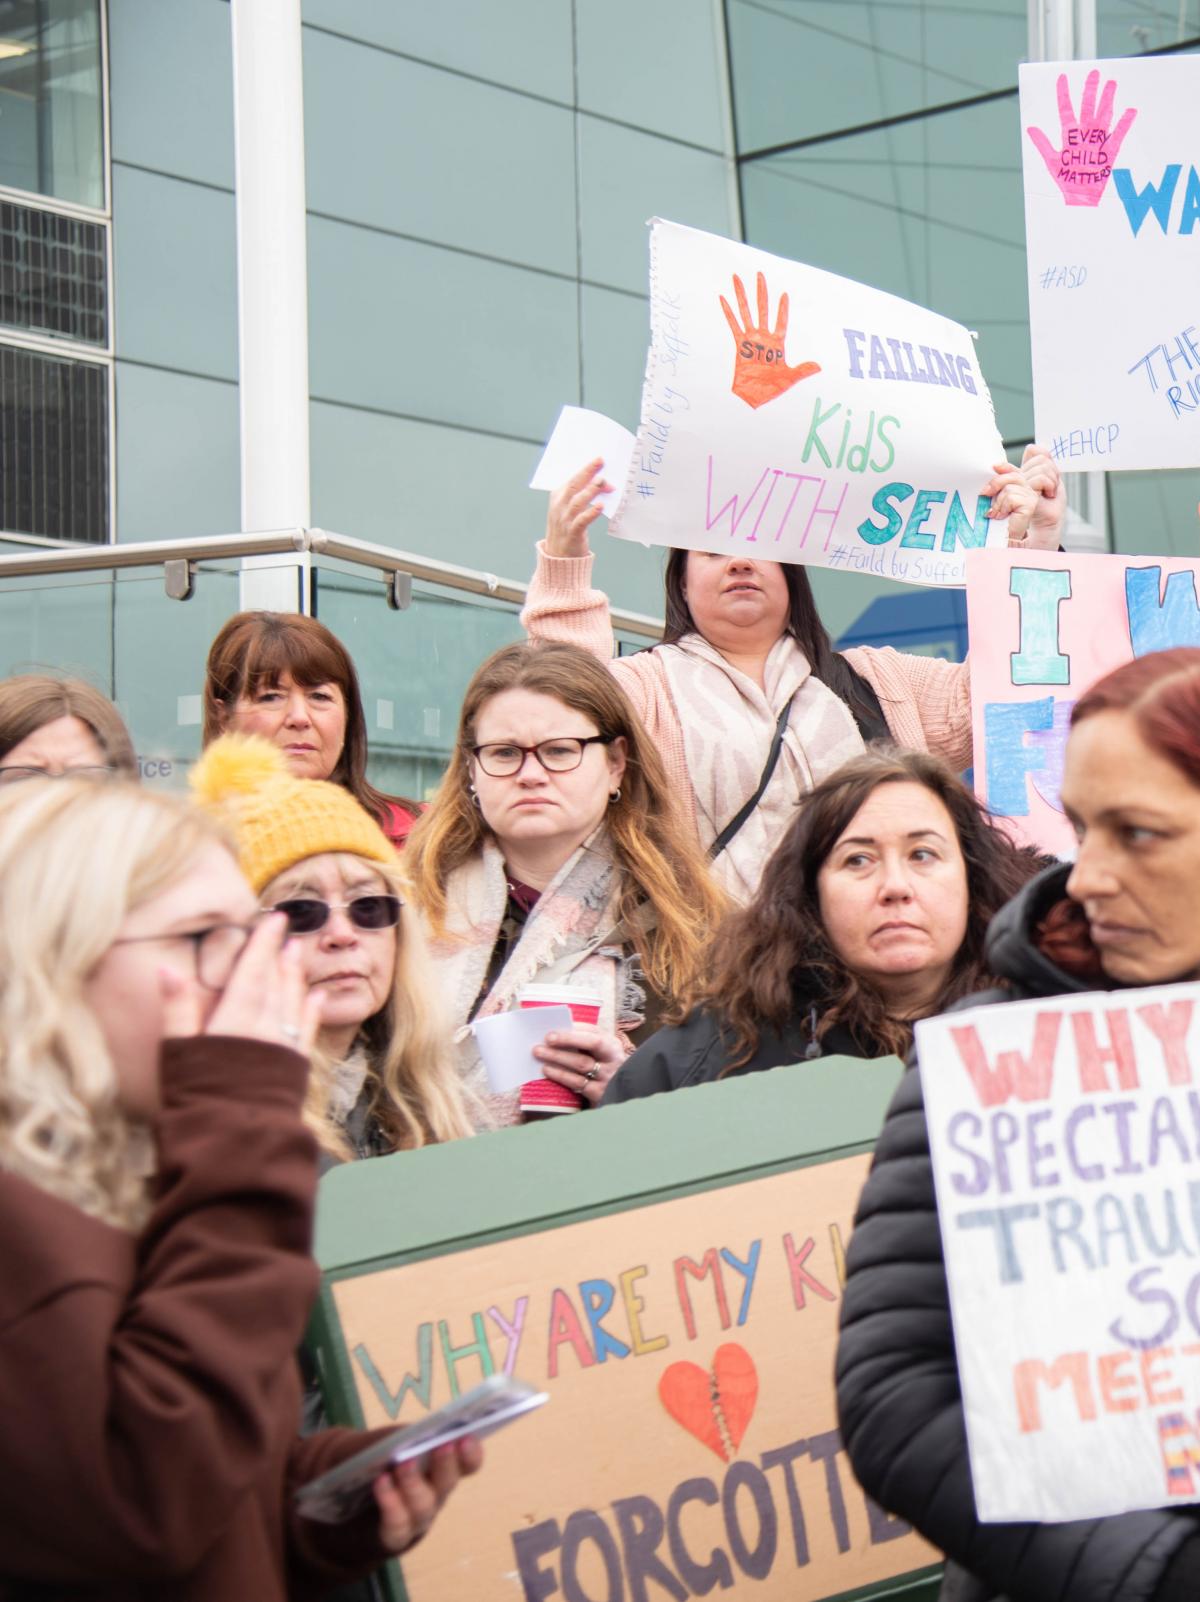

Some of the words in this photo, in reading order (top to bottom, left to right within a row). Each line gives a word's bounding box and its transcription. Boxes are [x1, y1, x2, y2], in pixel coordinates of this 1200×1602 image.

[1067, 128, 1112, 150] EVERY
[1057, 165, 1112, 185] MATTERS
[1061, 150, 1108, 167] CHILD
[1039, 266, 1088, 289] #ASD
[739, 340, 784, 366] STOP
[843, 328, 978, 396] FAILING
[1050, 423, 1120, 460] #EHCP
[705, 455, 849, 552] WITH
[857, 482, 992, 552] SEN
[890, 550, 909, 580] by
[1009, 566, 1072, 686] I
[948, 999, 1197, 1108] WHY
[354, 1295, 529, 1420] WHY
[547, 1264, 670, 1380] ARE
[673, 1239, 762, 1341] MY
